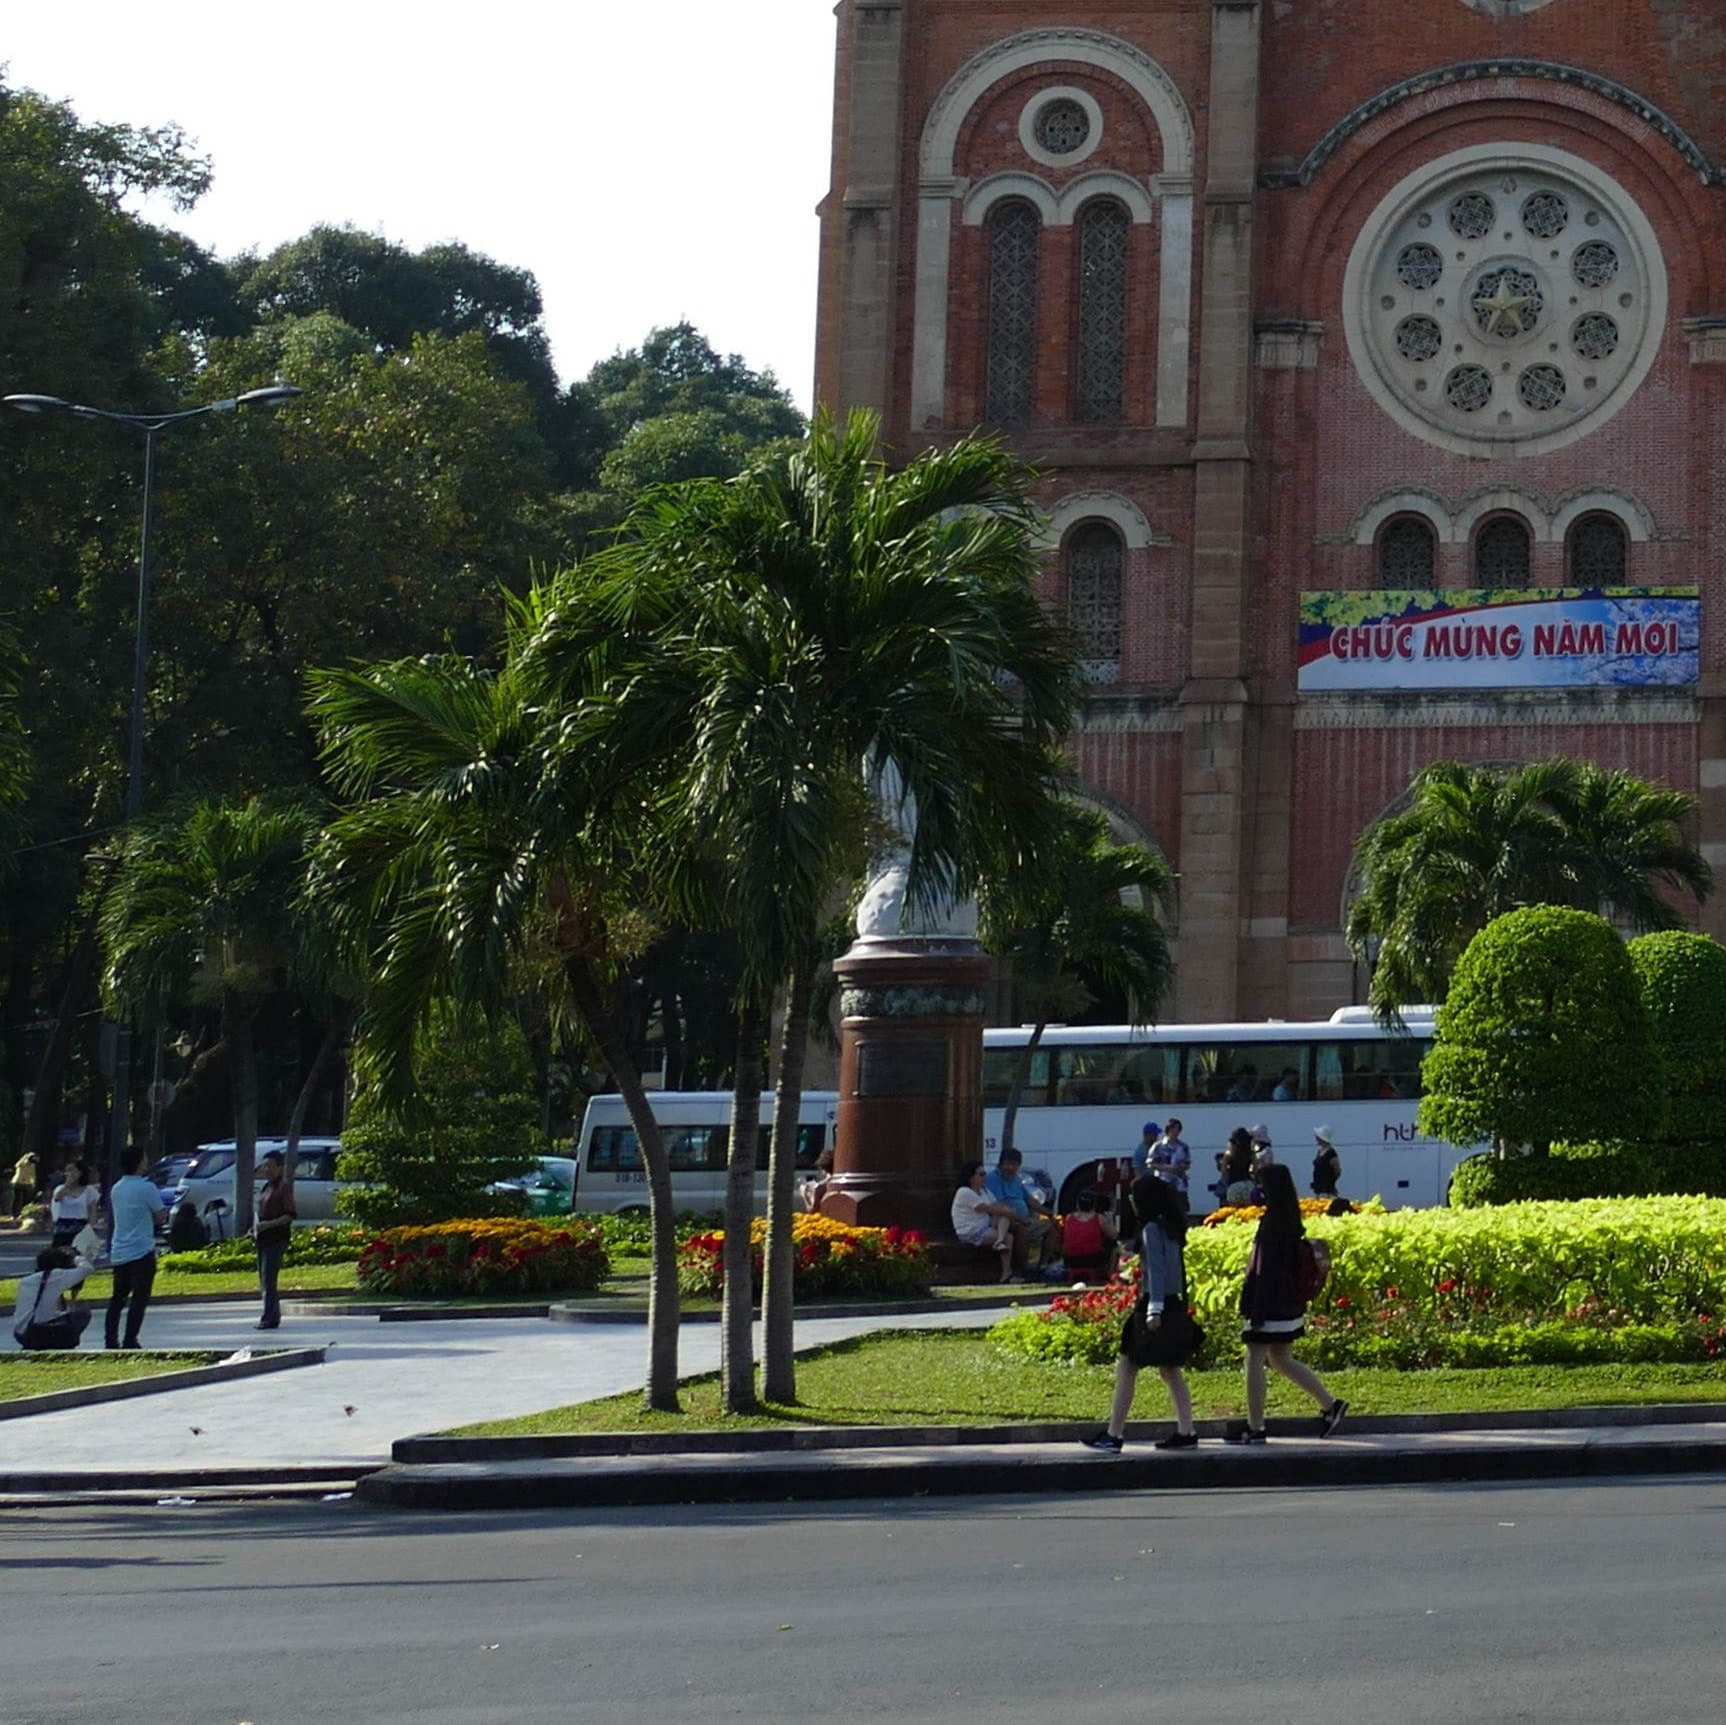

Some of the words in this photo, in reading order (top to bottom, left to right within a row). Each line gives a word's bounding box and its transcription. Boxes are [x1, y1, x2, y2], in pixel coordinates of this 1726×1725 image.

[1329, 617, 1414, 662] CHÚC
[1423, 618, 1523, 660] MỪNG
[1532, 618, 1606, 658] NĂM
